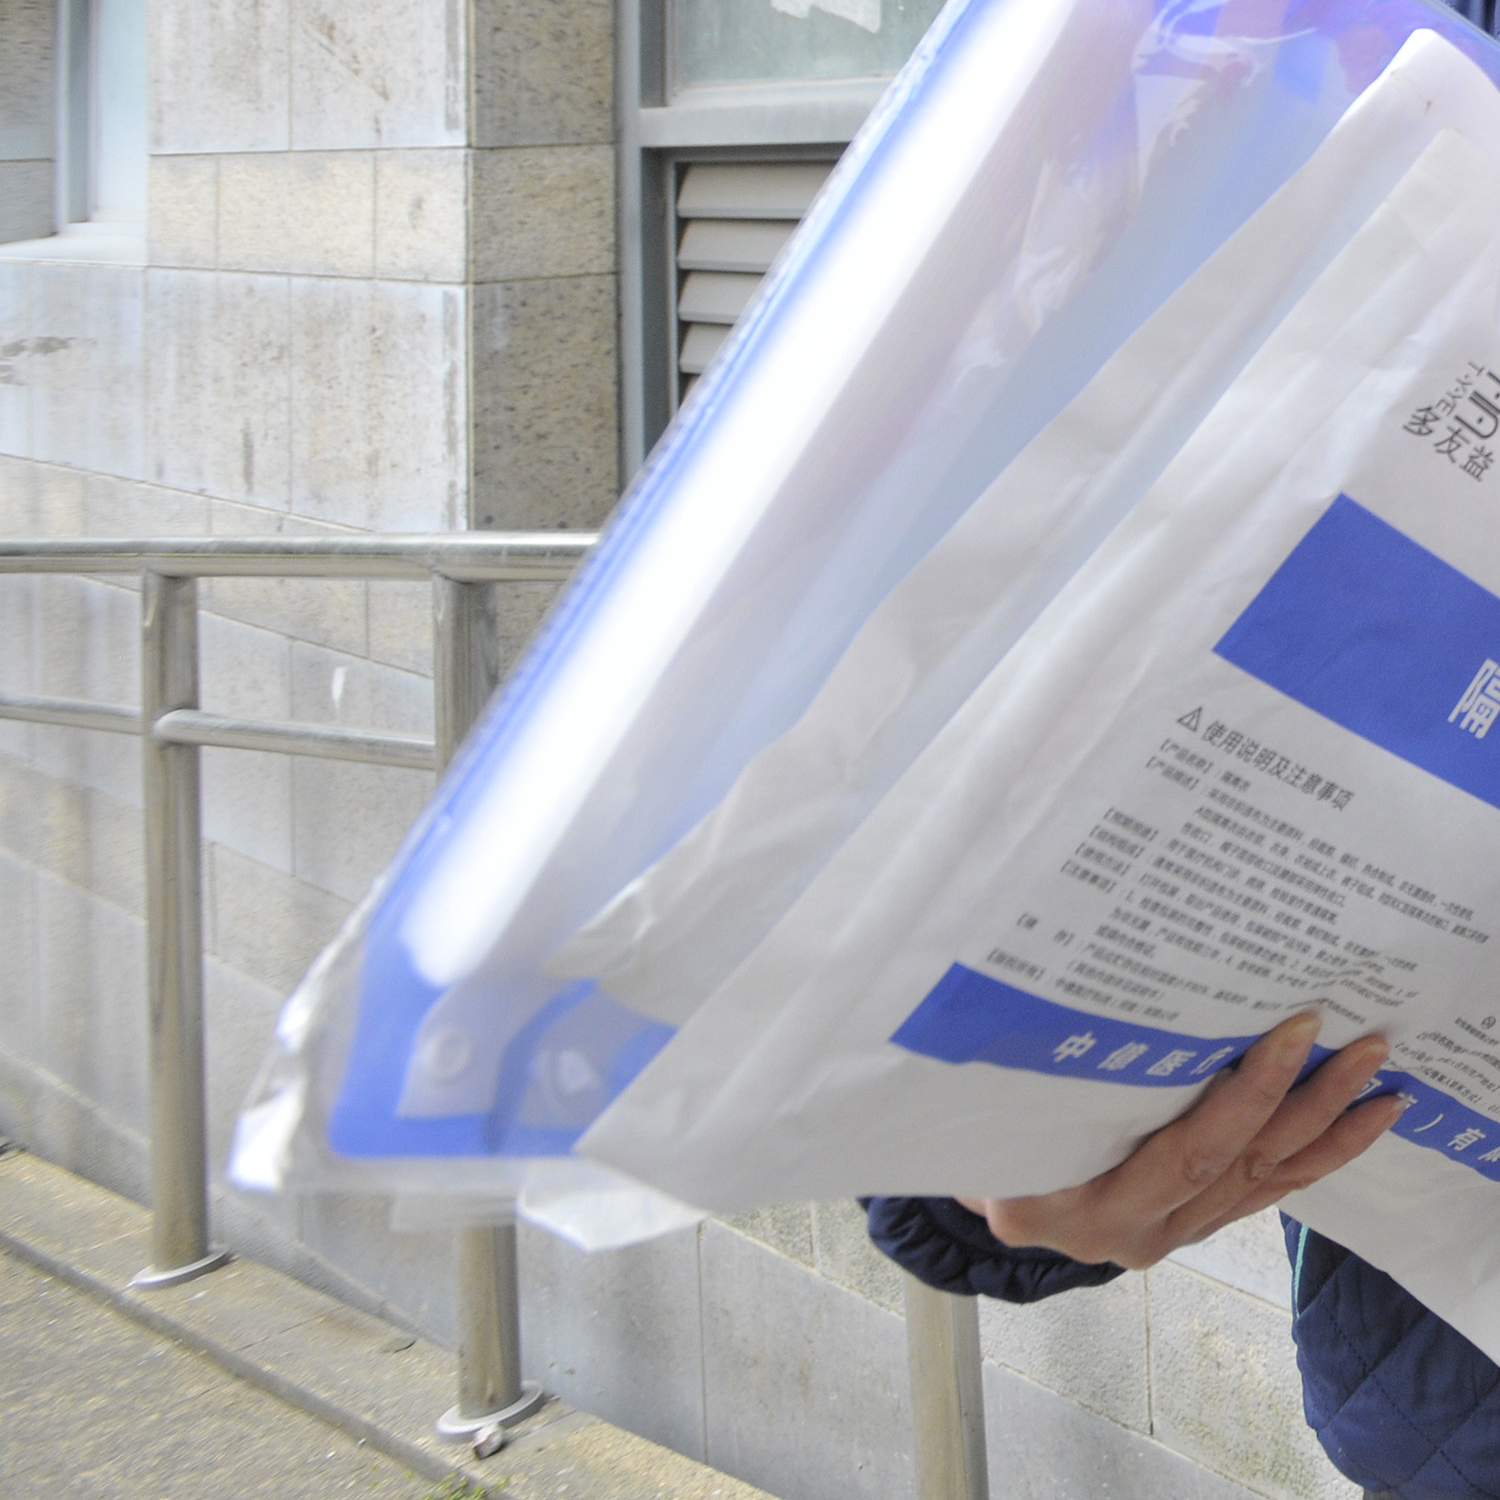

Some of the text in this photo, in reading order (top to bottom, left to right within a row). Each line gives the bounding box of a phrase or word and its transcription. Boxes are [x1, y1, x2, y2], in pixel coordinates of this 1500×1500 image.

[1402, 405, 1496, 483] 多友益
[1200, 721, 1355, 812] 使用说明及注意事项
